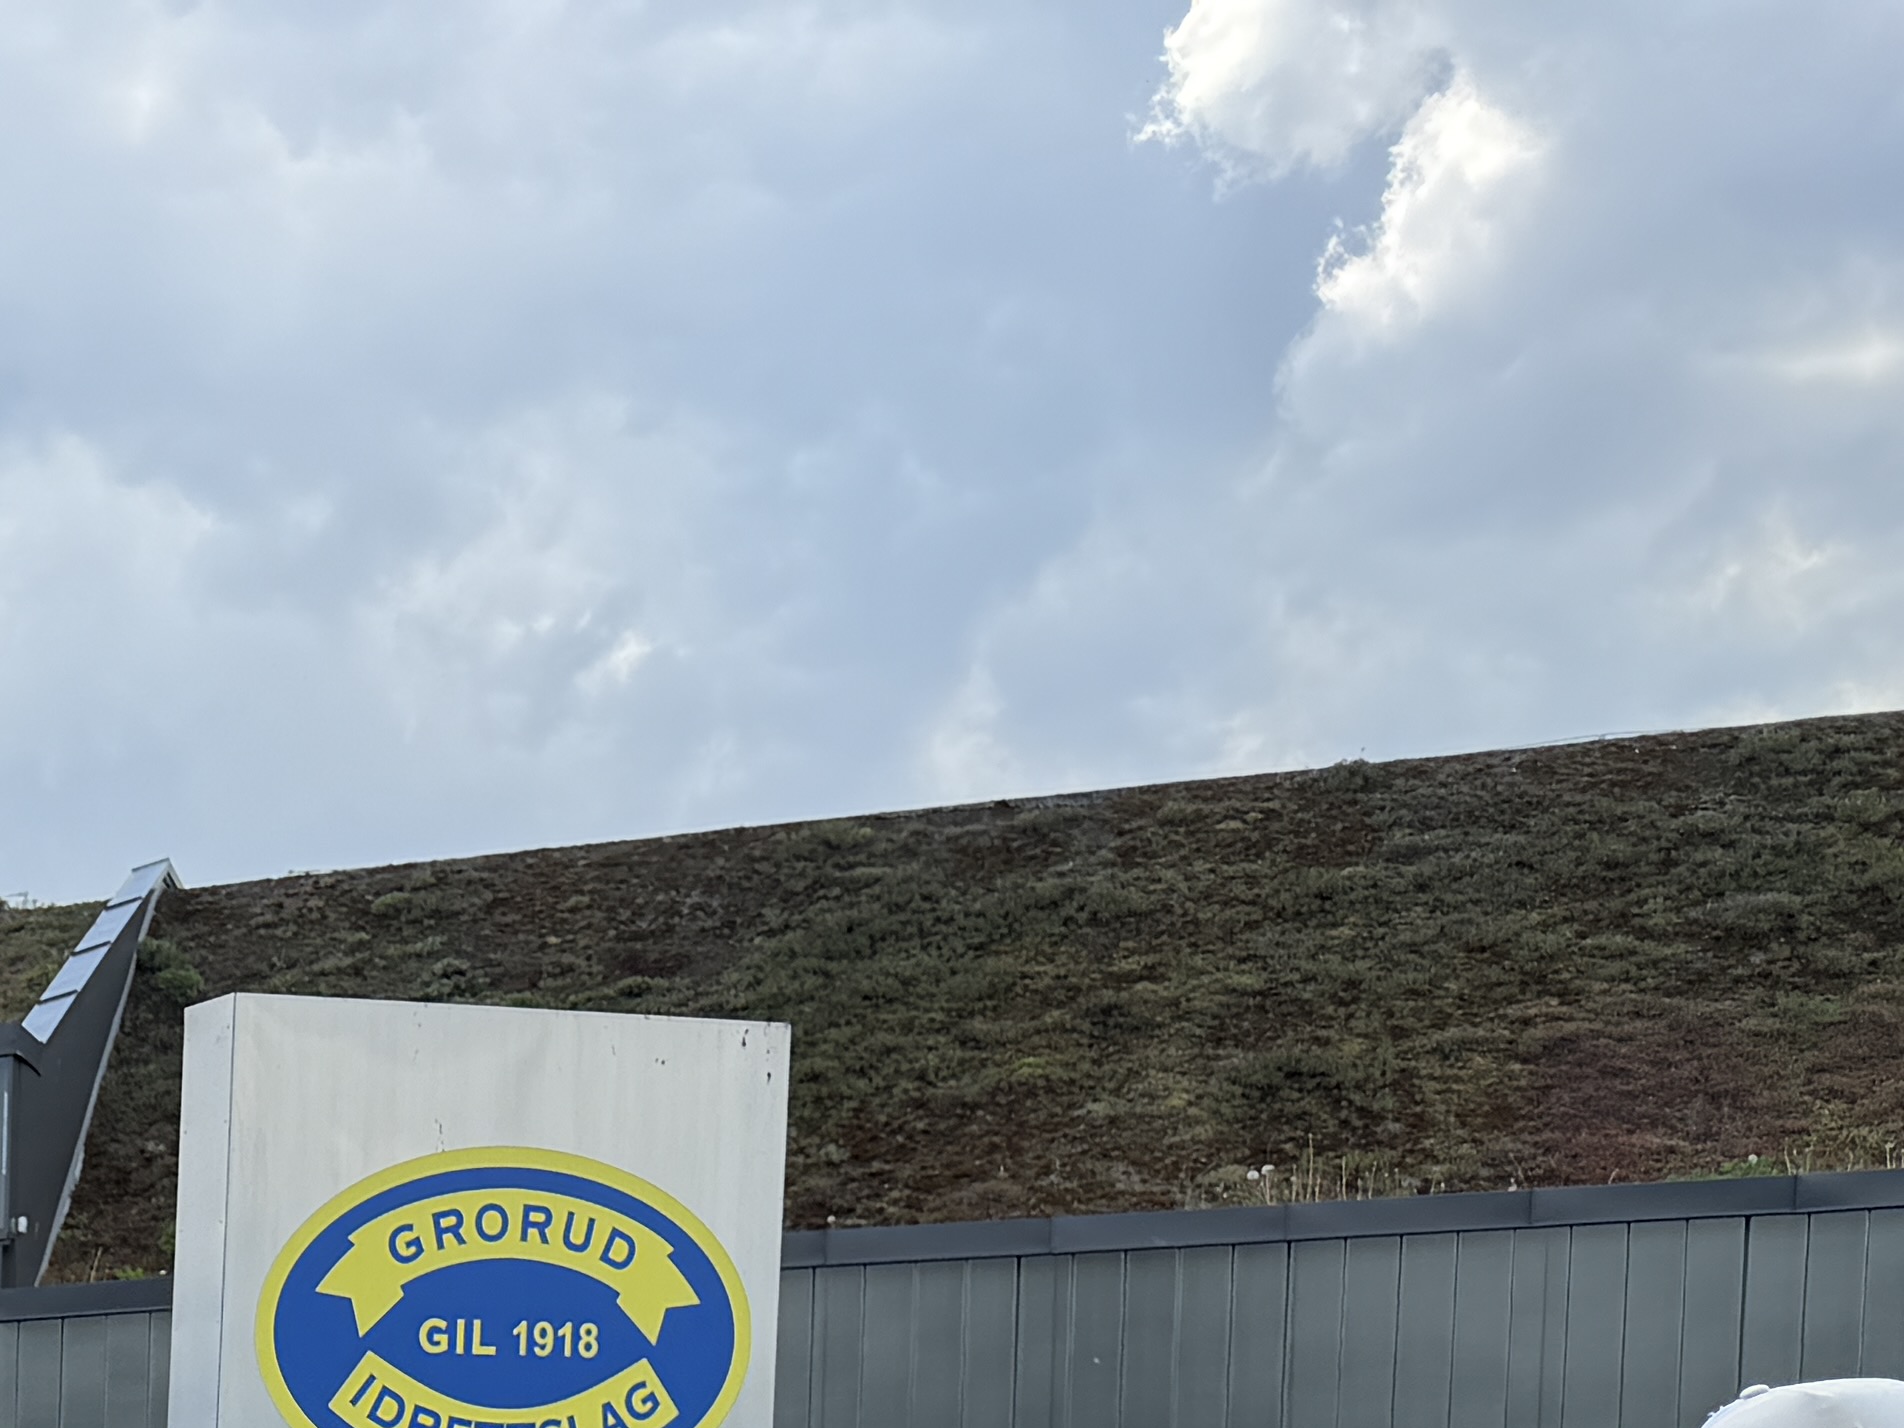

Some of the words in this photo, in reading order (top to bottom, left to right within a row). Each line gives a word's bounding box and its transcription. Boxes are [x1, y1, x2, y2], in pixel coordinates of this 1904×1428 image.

[387, 1203, 638, 1271] GRORUD
[418, 1317, 497, 1357] GIL
[511, 1319, 600, 1359] 1918
